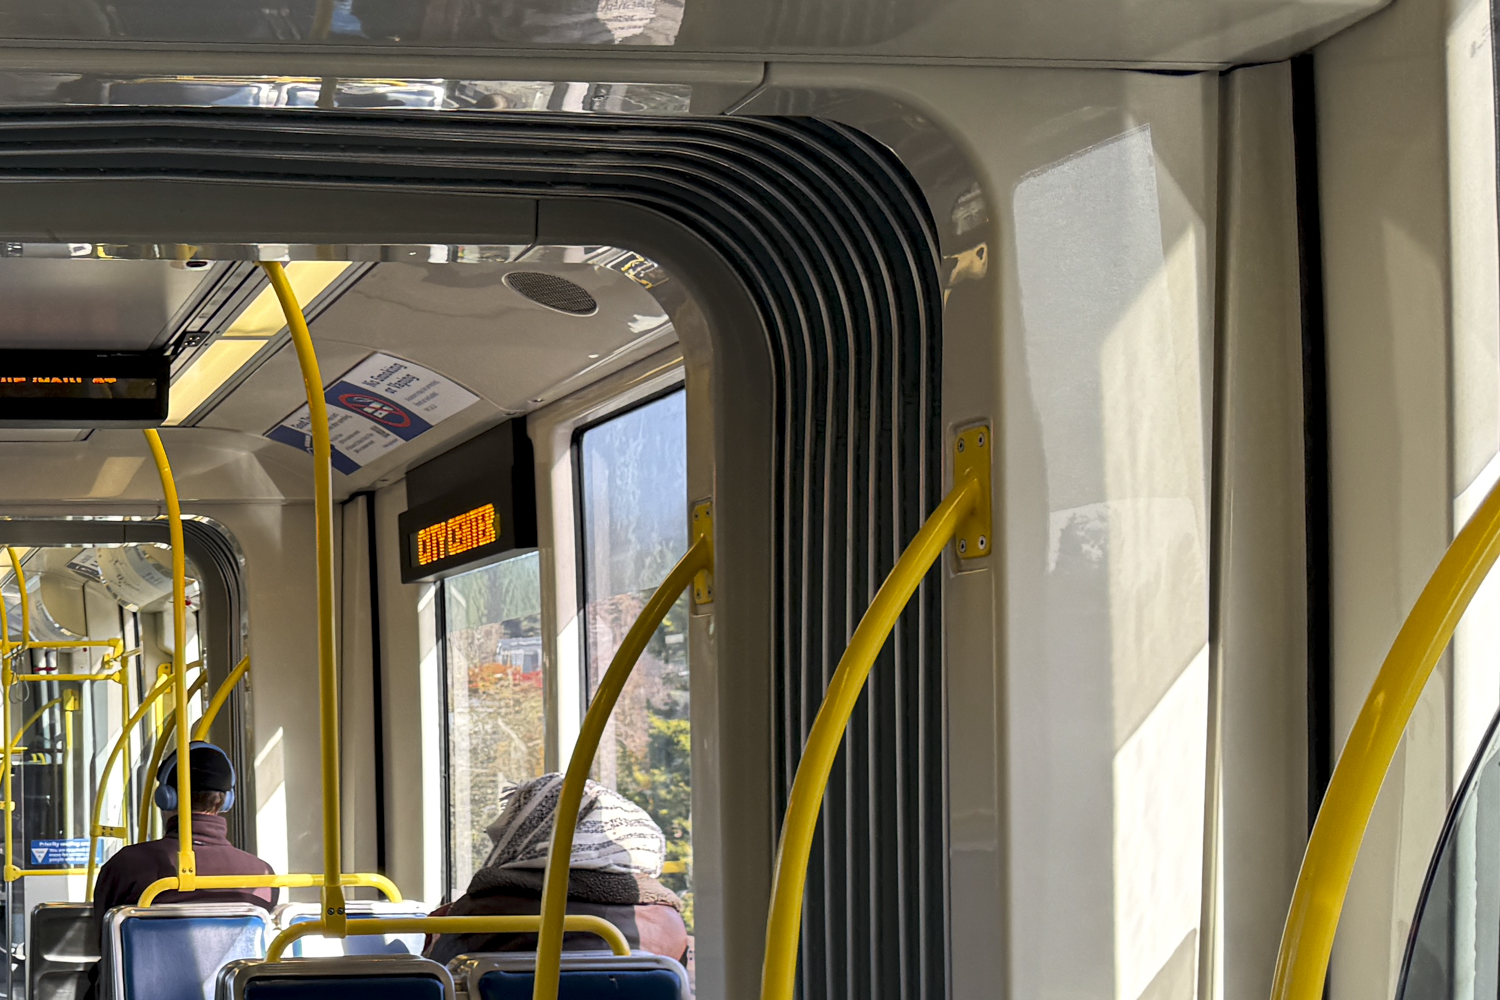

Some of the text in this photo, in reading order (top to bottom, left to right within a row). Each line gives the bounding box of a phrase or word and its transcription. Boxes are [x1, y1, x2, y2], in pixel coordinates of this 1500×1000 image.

[370, 362, 408, 382] Smoking
[387, 374, 420, 389] Vaping
[418, 503, 497, 566] CITY CENTER
